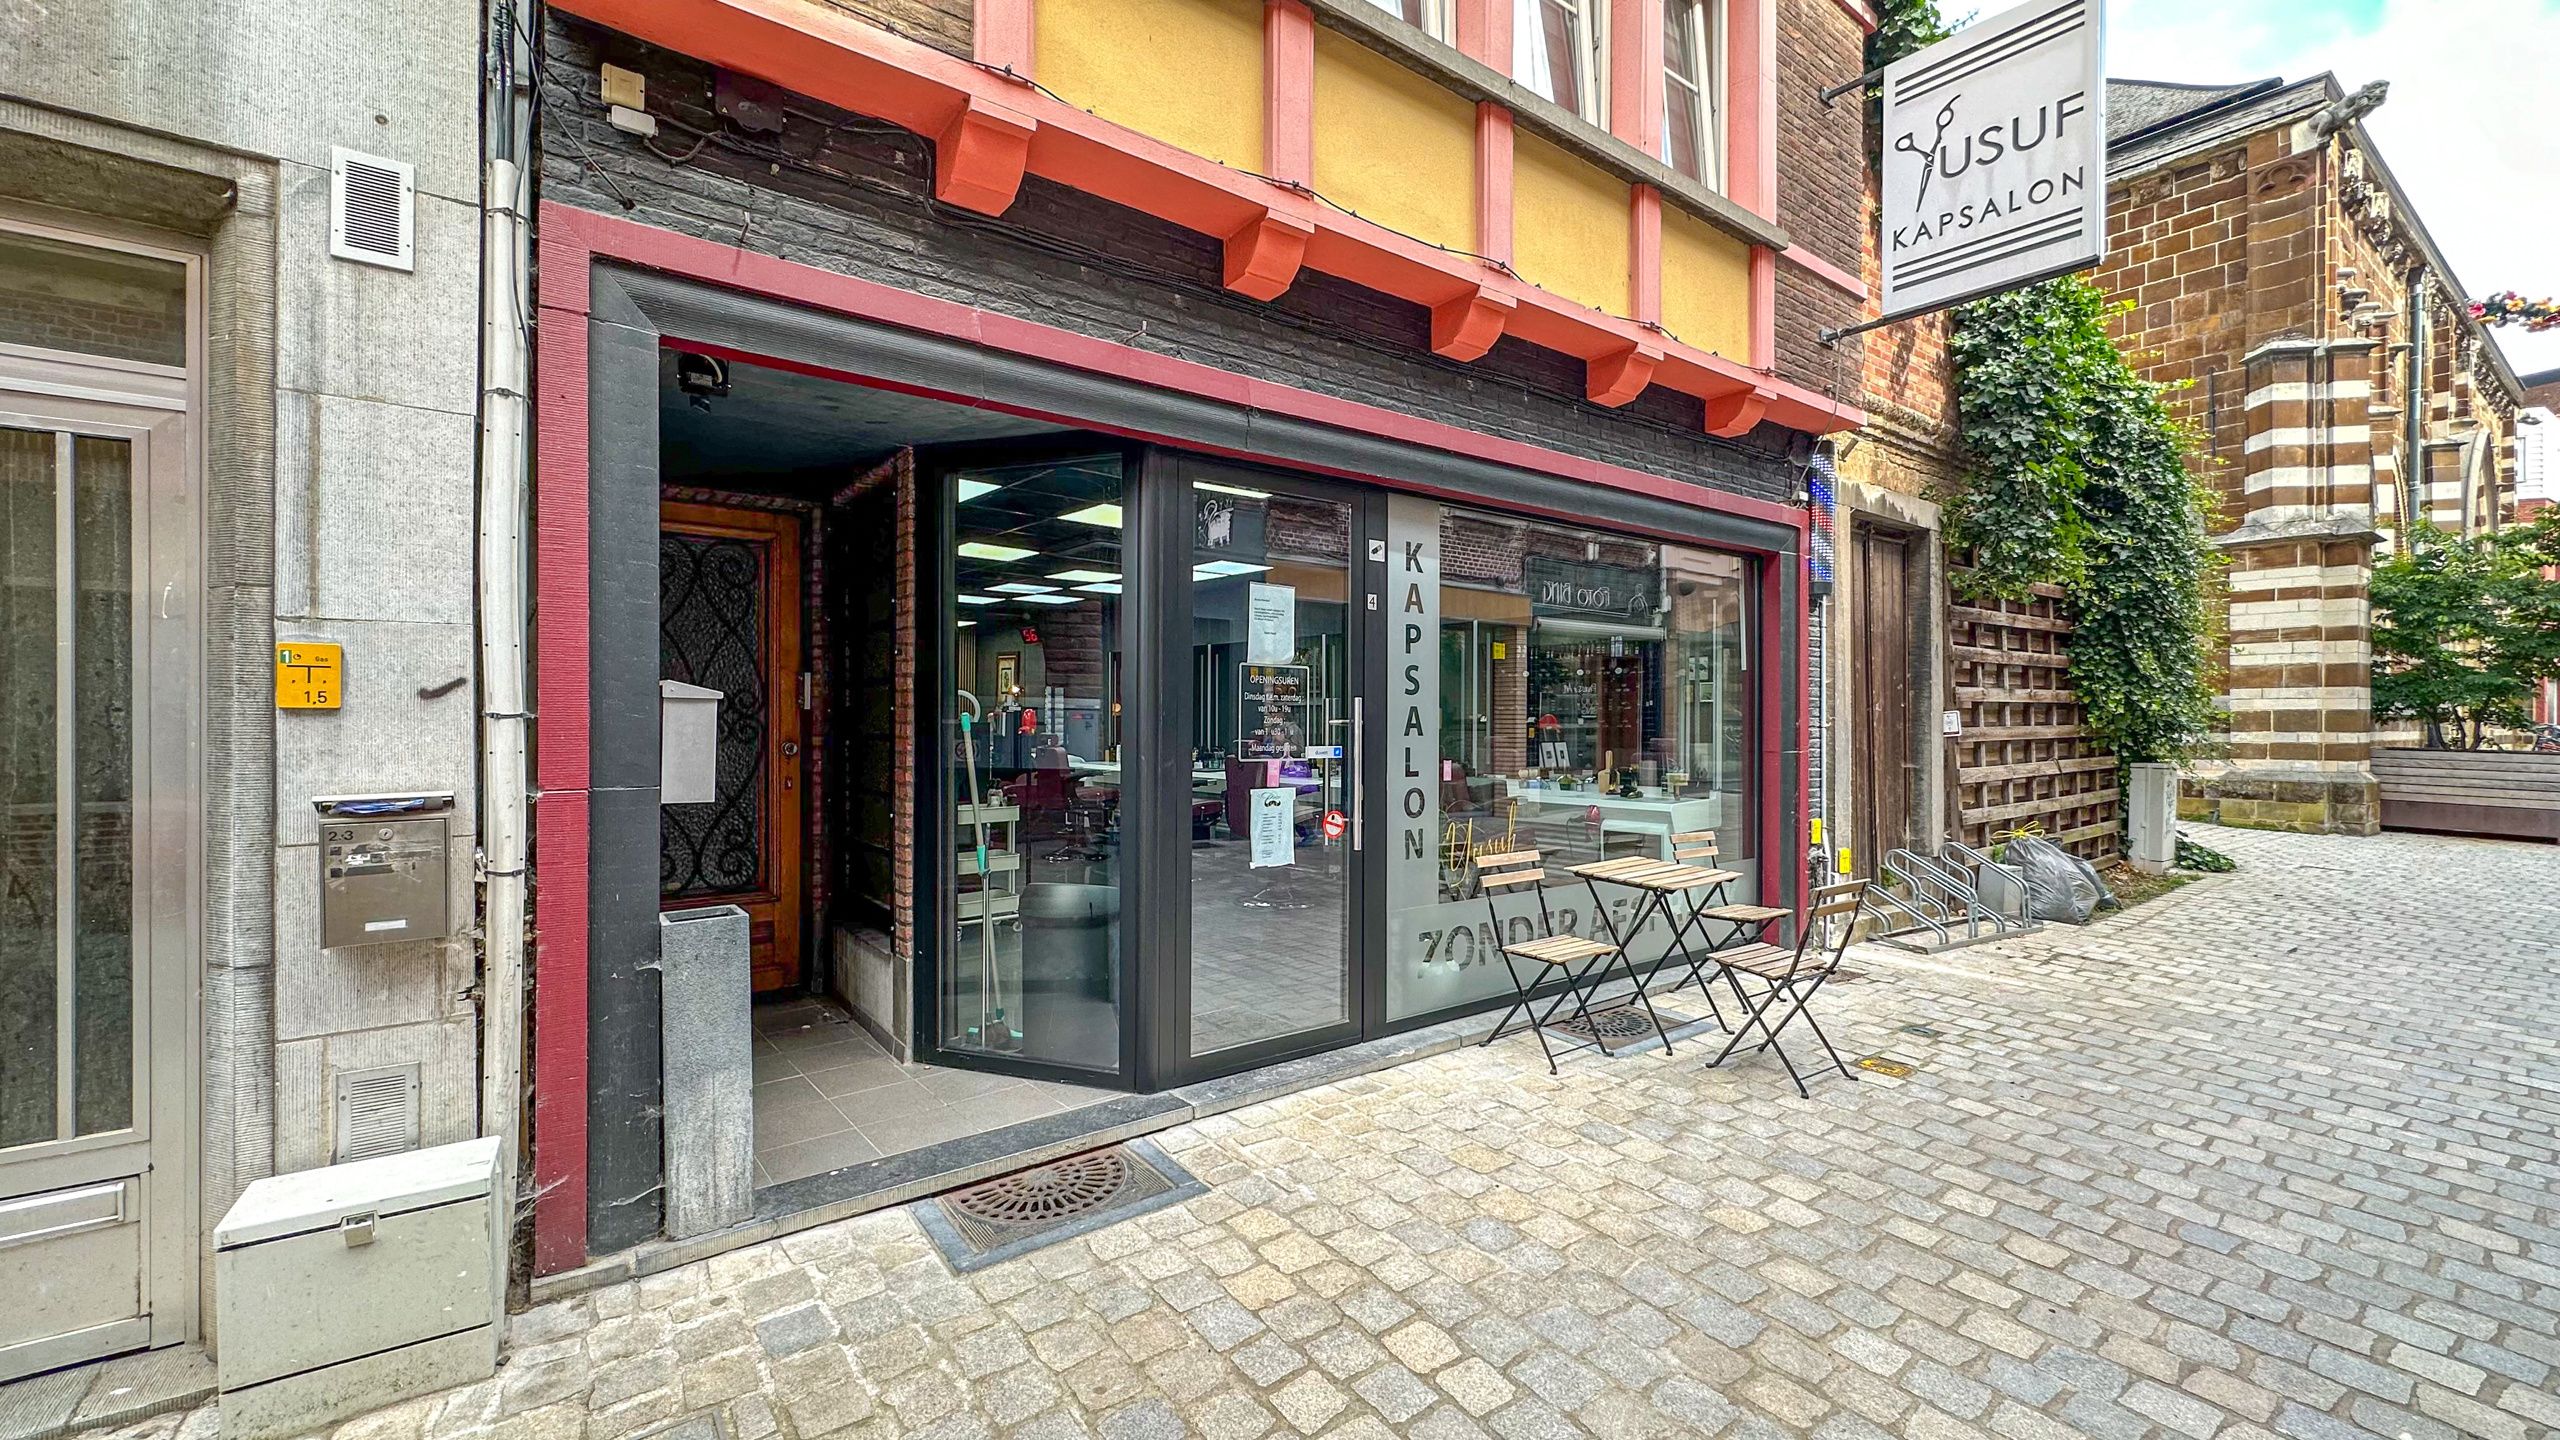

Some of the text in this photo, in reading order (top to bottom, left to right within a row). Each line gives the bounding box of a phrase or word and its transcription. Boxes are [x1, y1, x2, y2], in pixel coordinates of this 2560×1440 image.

[1893, 165, 2084, 252] KAPSALON
[1368, 596, 1376, 609] 4
[1249, 675, 1299, 685] OPENINGSUREN
[1244, 691, 1266, 702] Dinsdag
[1403, 540, 1426, 861] KAPSALON
[1263, 715, 1283, 725] Zondag
[1418, 907, 1579, 979] ZONDER
